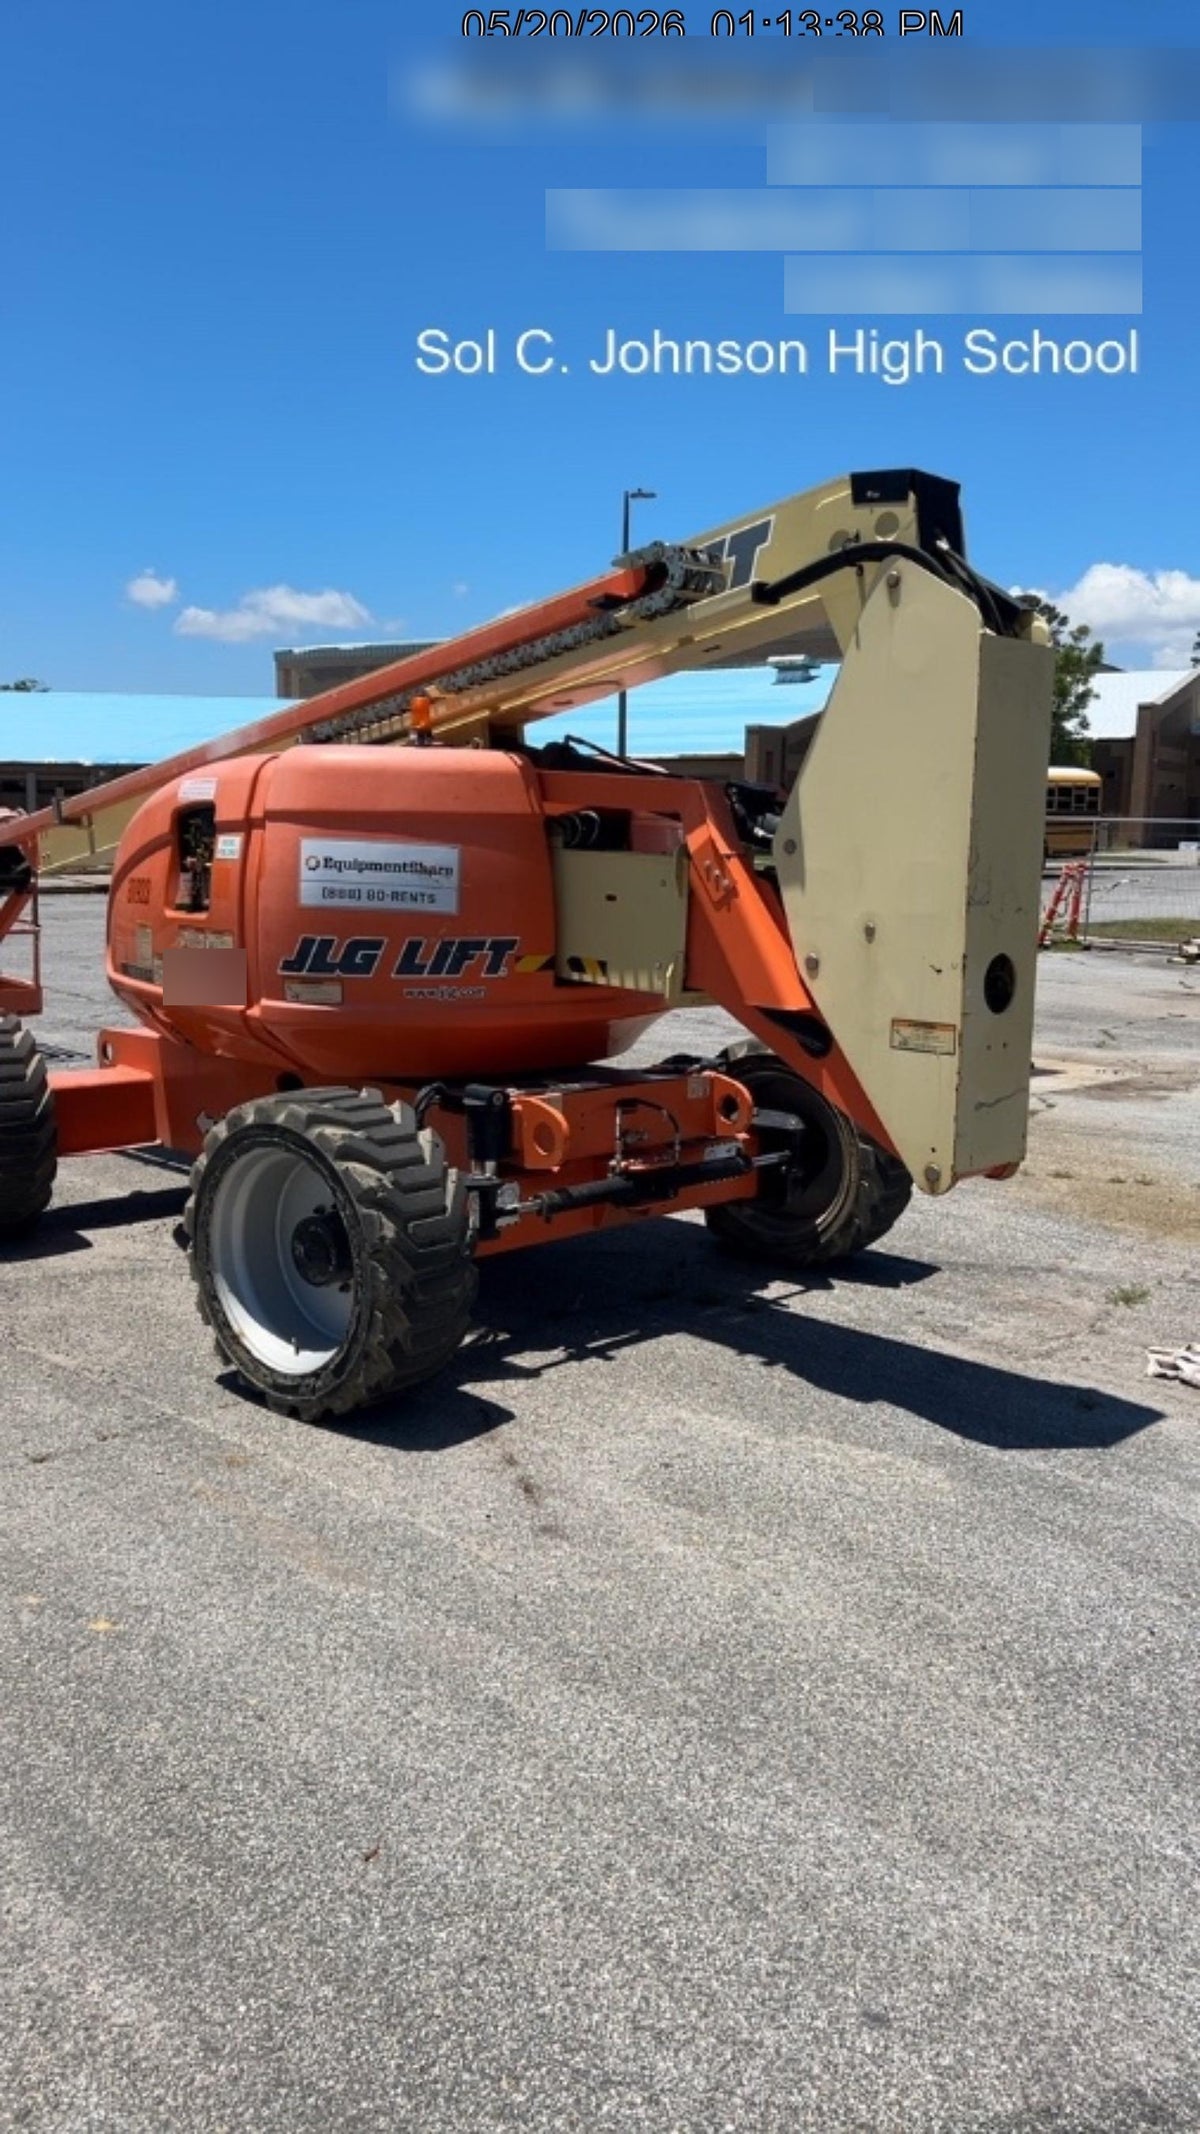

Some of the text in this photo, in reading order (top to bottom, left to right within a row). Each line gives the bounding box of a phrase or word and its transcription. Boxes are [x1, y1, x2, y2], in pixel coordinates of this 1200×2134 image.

[366, 889, 436, 905] 80-RENTS
[278, 936, 389, 977] JLG
[392, 937, 519, 978] LIFT
